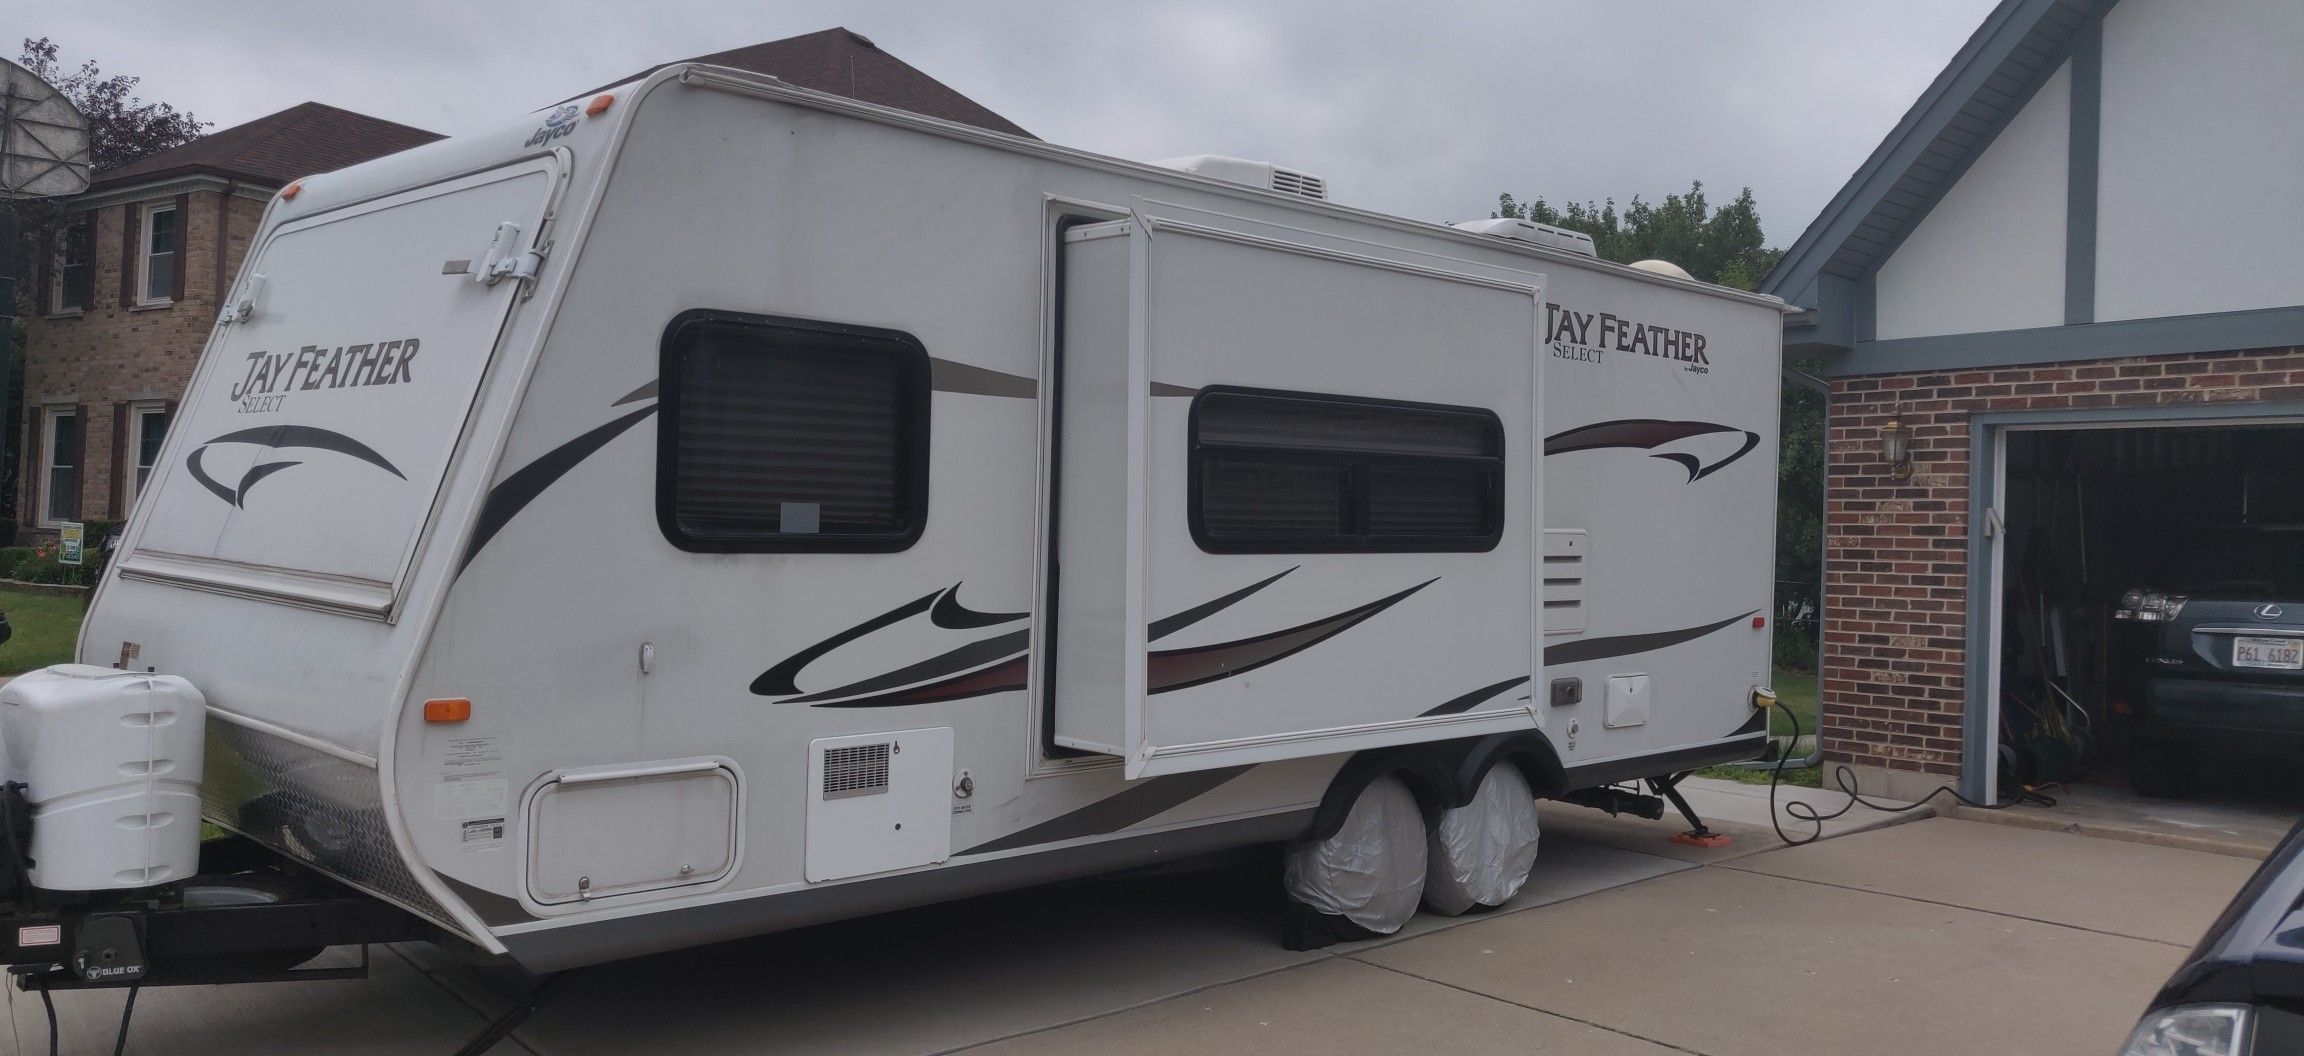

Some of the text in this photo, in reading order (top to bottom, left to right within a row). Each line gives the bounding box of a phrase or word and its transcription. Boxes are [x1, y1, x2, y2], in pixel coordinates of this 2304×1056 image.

[524, 121, 577, 148] Jayco
[1545, 302, 1709, 365] JAY FEATHER
[1553, 342, 1604, 364] SELECT
[231, 338, 420, 402] JAY FEATHER
[1688, 362, 1709, 375] Jayco
[238, 394, 287, 414] SELECT
[2237, 646, 2259, 662] P61
[102, 965, 141, 976] BLUE OX
